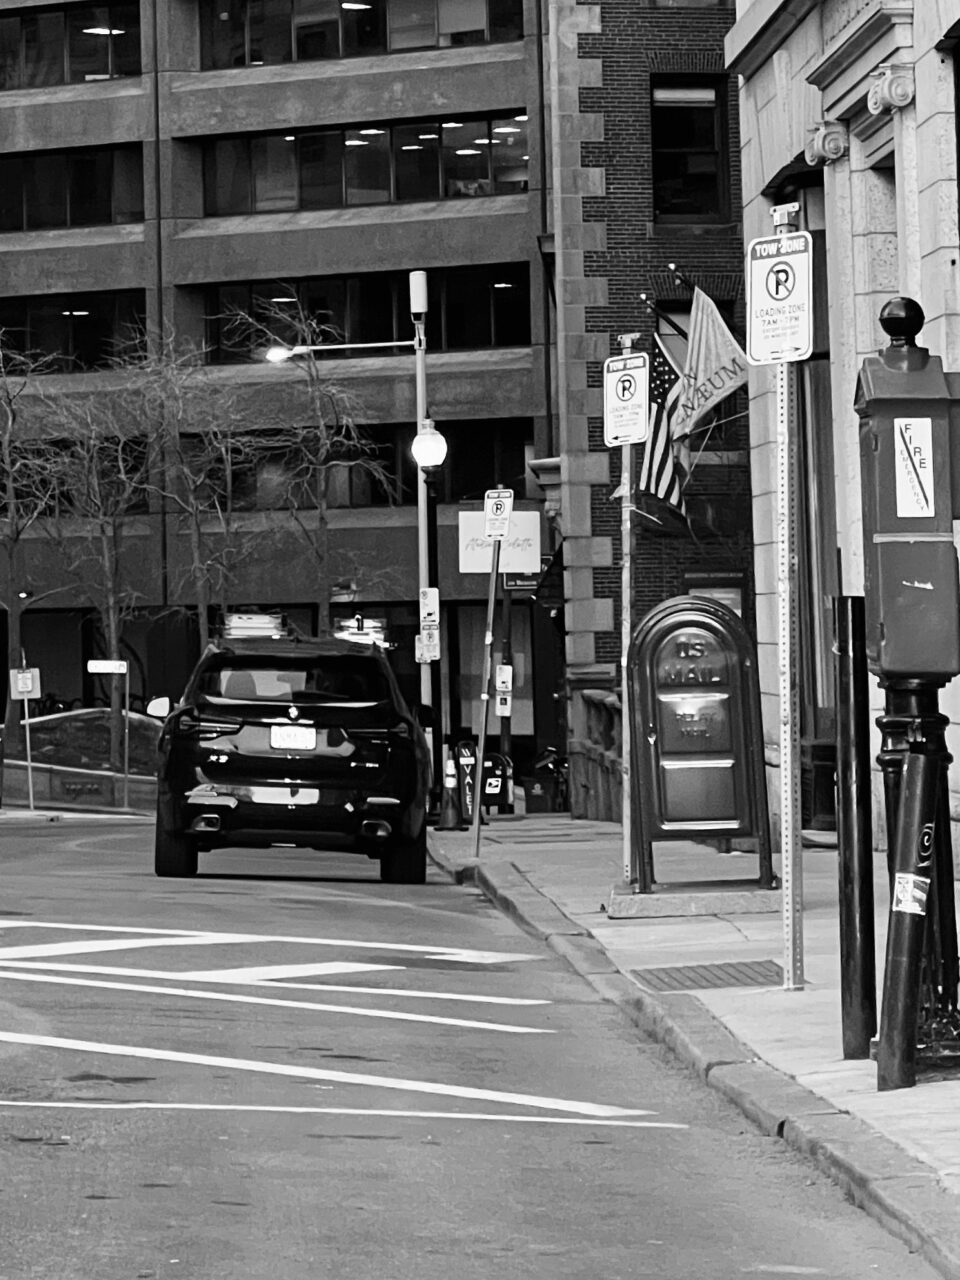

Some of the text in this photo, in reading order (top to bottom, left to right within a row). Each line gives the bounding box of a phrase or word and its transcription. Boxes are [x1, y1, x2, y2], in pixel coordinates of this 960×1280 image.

[754, 242, 778, 257] TOW
[755, 302, 806, 319] LOADING ZONE
[761, 317, 778, 327] 7AM
[904, 423, 928, 469] FIRE
[900, 449, 925, 511] EMERGENCY
[464, 765, 473, 815] VALET
